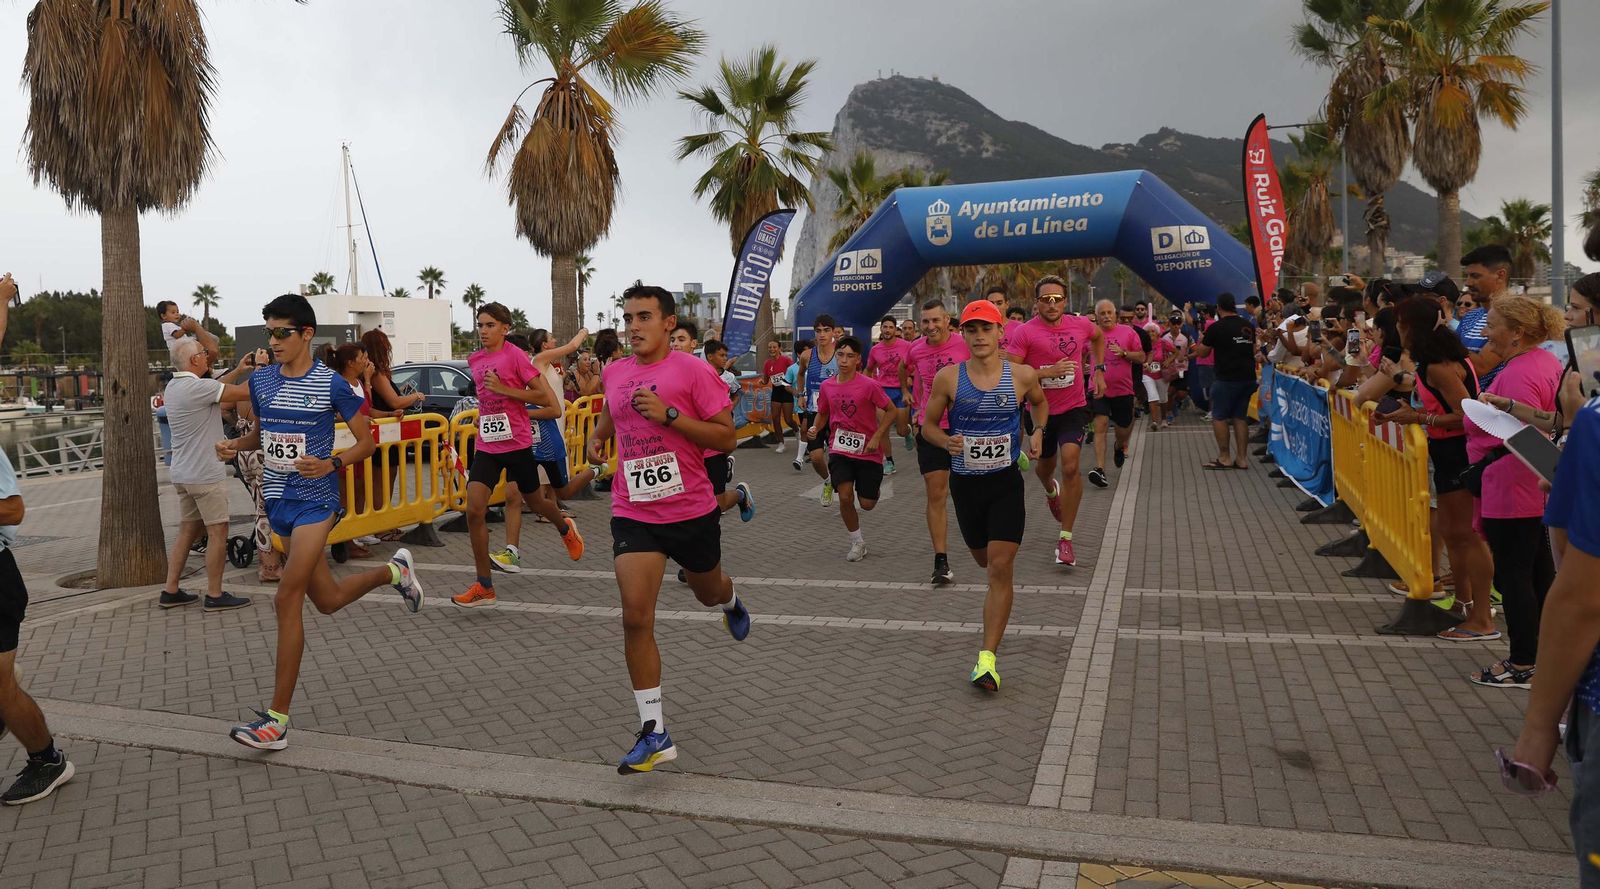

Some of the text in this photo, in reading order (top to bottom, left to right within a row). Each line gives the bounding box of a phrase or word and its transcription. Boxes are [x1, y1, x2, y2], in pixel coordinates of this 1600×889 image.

[1254, 174, 1277, 217] Ruiz
[957, 192, 1104, 221] Ayuntamiento
[974, 215, 1089, 240] de La Línea
[757, 232, 777, 247] UBAGO
[1158, 232, 1174, 249] D
[839, 256, 853, 271] D
[1154, 251, 1192, 261] DELEGACIÓN
[1155, 258, 1212, 272] DEPORTES
[732, 252, 773, 322] UBAGO
[832, 281, 883, 292] DEPORTES
[483, 421, 506, 434] 552
[838, 435, 860, 449] 639
[267, 443, 298, 459] 463
[970, 445, 1005, 459] 542
[630, 465, 672, 489] 766
